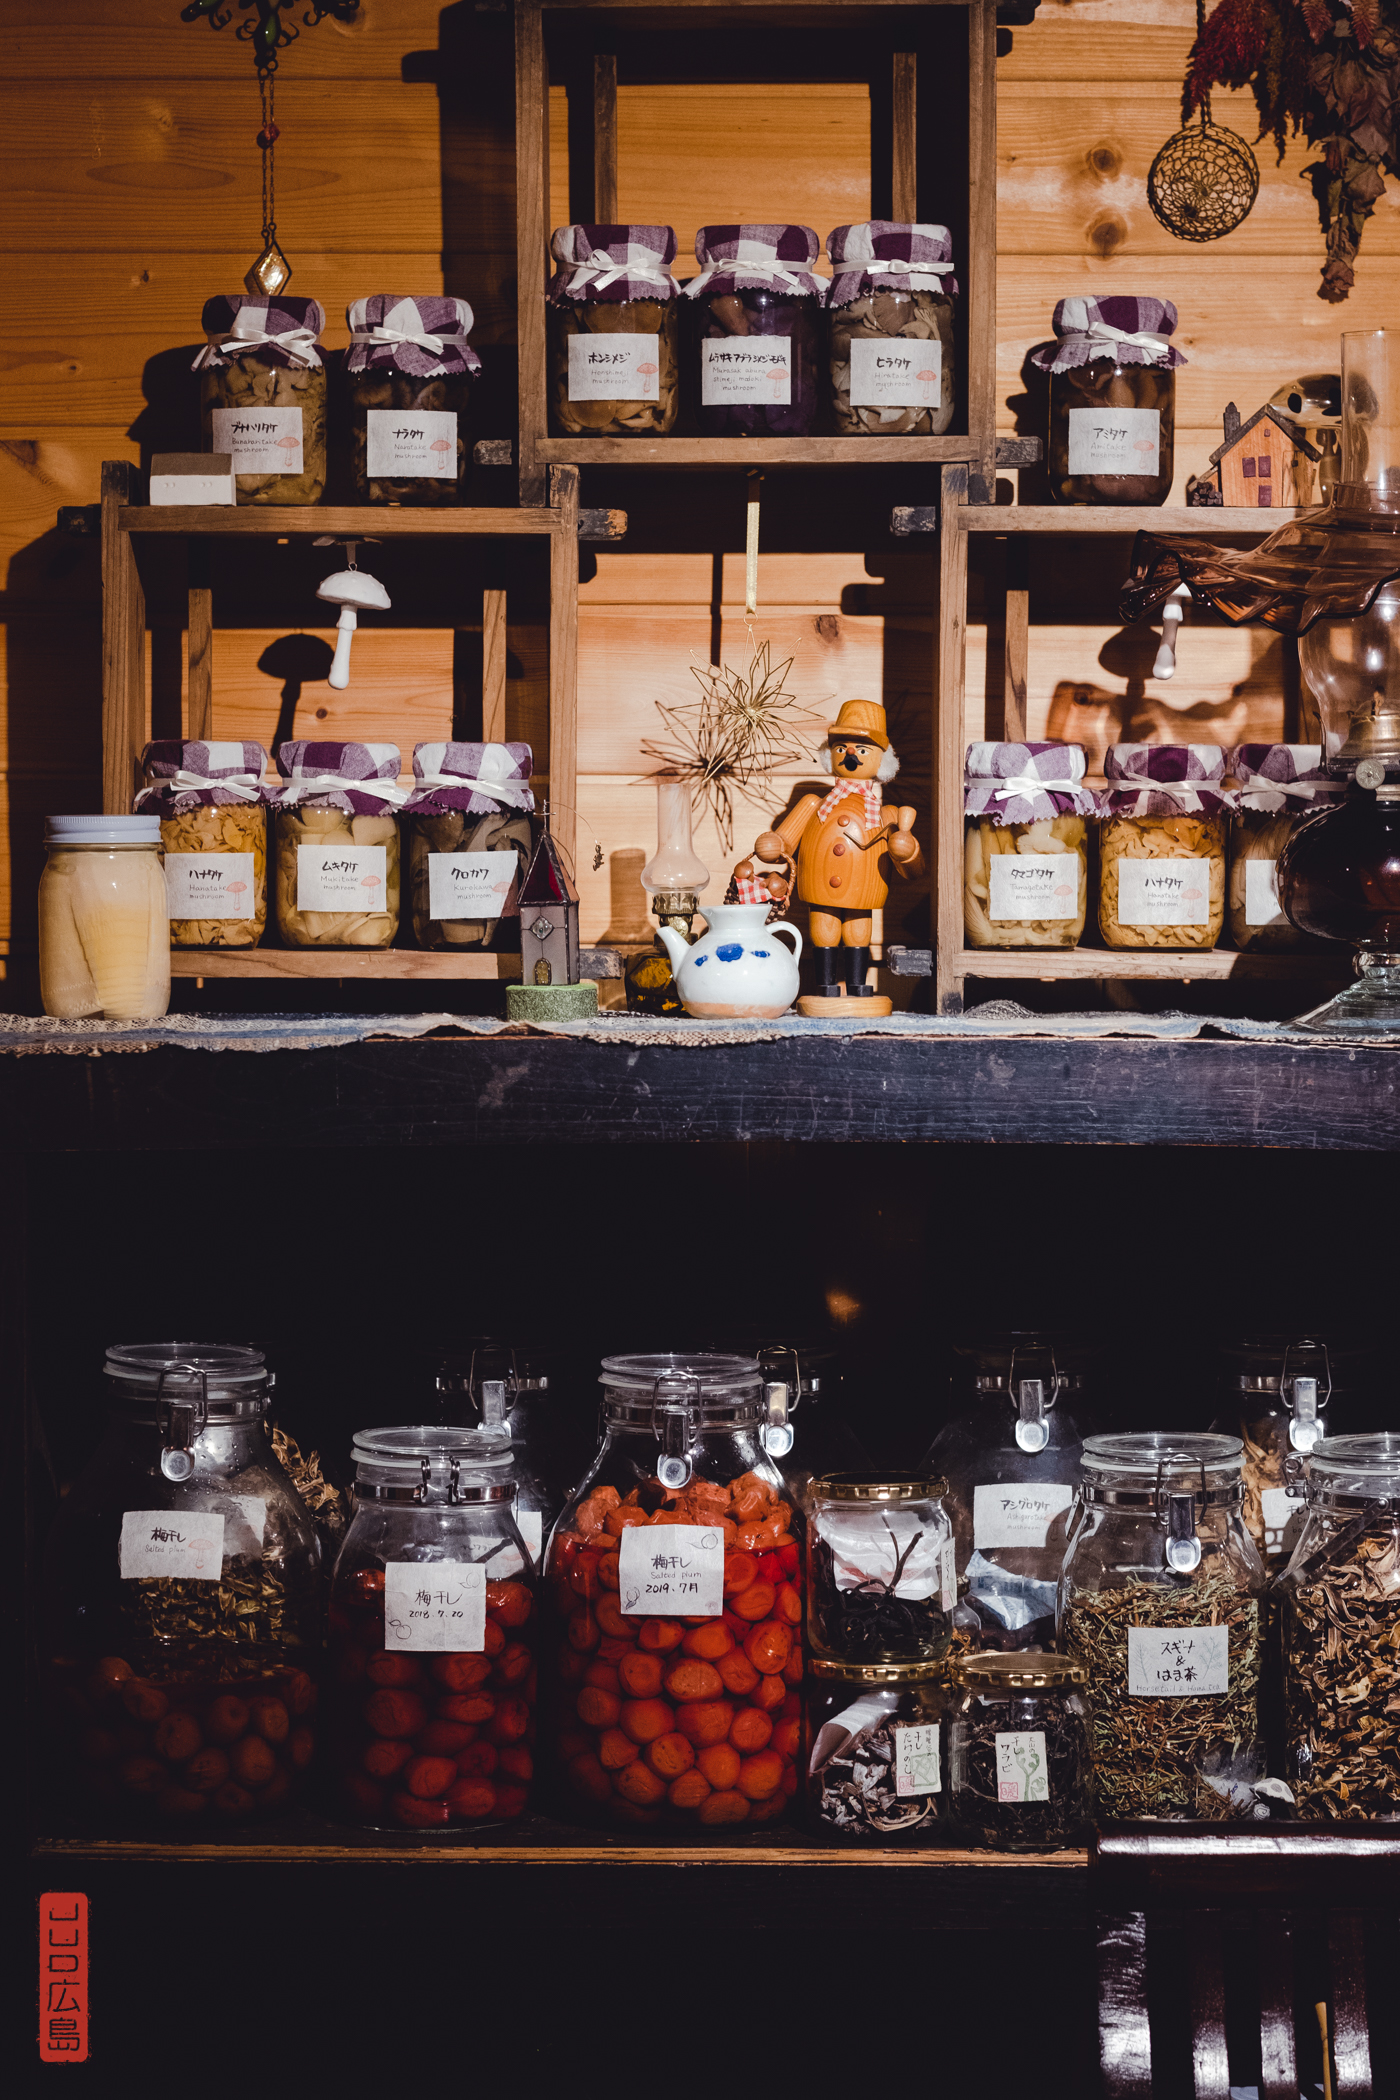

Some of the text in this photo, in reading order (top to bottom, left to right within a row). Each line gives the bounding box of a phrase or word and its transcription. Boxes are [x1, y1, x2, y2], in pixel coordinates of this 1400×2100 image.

[588, 351, 631, 365] ホンシメジ
[876, 356, 911, 370] ヒラタケ
[231, 420, 278, 433] ブナハリタケ
[392, 428, 425, 440] ナラタケ
[1093, 427, 1129, 441] アミタケ
[1090, 442, 1126, 450] Amitake
[322, 860, 358, 873] ムキタケ
[189, 869, 224, 881] ハナタケ
[451, 867, 489, 880] クロカワ
[1011, 868, 1055, 880] タマゴタケ
[189, 884, 227, 892] Hanatake
[1145, 877, 1183, 889] ハナタケ
[1001, 1498, 1050, 1510] アシグロタケ
[150, 1527, 187, 1543] 梅干し
[144, 1545, 165, 1553] Salted
[650, 1553, 693, 1570] 梅干し
[650, 1571, 702, 1580] Salted plum
[415, 1589, 463, 1606] 梅干し
[1160, 1639, 1196, 1656] スギナ
[1175, 1656, 1186, 1667] &
[1156, 1667, 1198, 1683] はま茶
[1136, 1684, 1176, 1692] Horsetail
[1000, 1743, 1012, 1773] ワラビ
